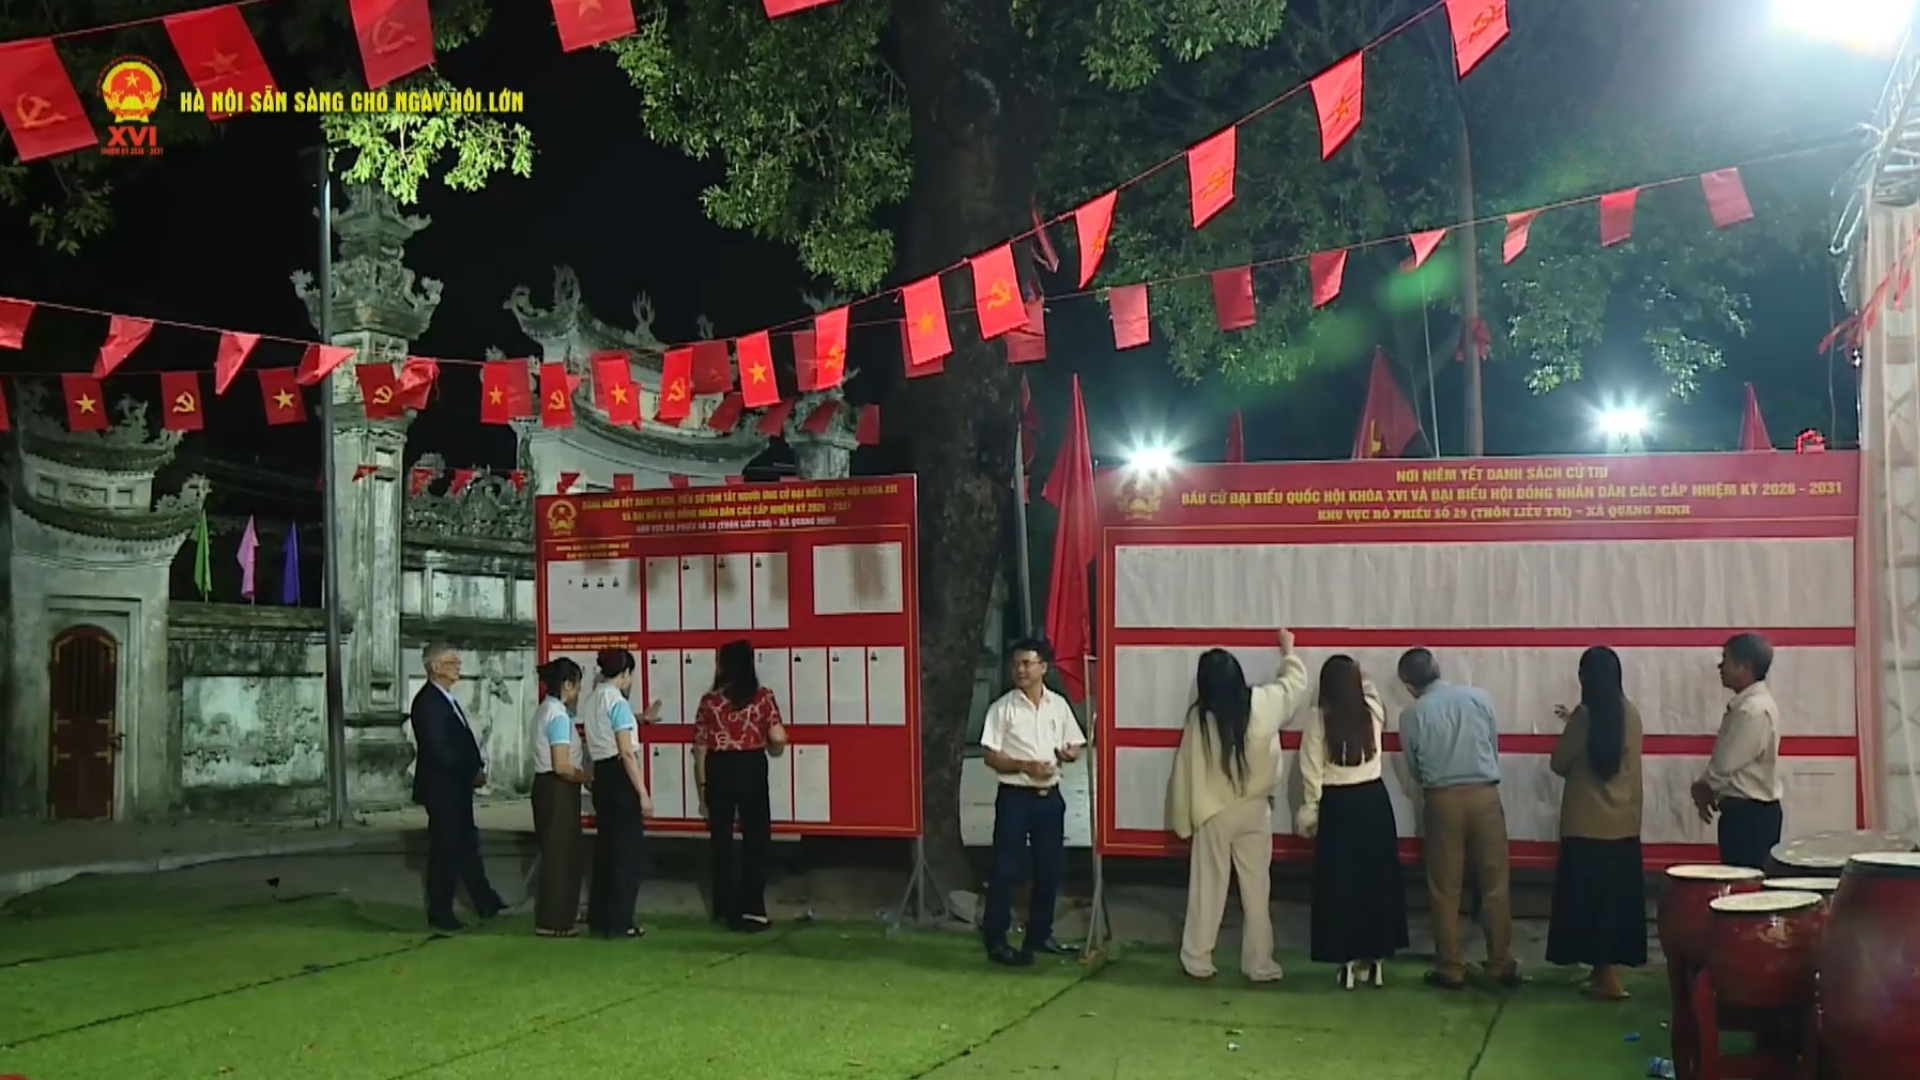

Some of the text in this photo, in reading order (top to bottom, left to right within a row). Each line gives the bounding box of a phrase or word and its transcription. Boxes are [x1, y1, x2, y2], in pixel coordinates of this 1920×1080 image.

[1396, 462, 1608, 483] NƠI NIÊM YẾT DANH SÁCH CỬ TRI
[1210, 488, 1228, 505] CỬ
[1230, 491, 1251, 508] ĐẠI
[1255, 487, 1284, 505] BIỂU
[1287, 486, 1320, 505] QUỐC
[1324, 488, 1345, 506] HỘI
[1348, 487, 1384, 503] KHÓA
[1386, 490, 1408, 503] XVI
[1411, 486, 1428, 502] VÀ
[1431, 487, 1453, 504] ĐẠI
[1457, 484, 1487, 501] BIỂU
[1490, 486, 1513, 504] HỘI
[1516, 484, 1553, 501] ĐỒNG
[1557, 484, 1594, 499] NHÂN
[1598, 483, 1625, 498] DÂN
[1629, 482, 1657, 497] CÁC
[1661, 481, 1688, 497] CẤP
[1692, 482, 1737, 499] NHIỆM
[1762, 483, 1796, 496] 2026
[1809, 481, 1842, 495] 2031
[1318, 509, 1343, 521] KHU
[1346, 508, 1369, 523] VỰC
[1373, 506, 1390, 520] BỎ
[1393, 506, 1431, 520] PHIẾU
[1434, 504, 1450, 519] SỐ
[1470, 505, 1511, 521] (THÔN
[1586, 503, 1604, 517] XÃ
[1608, 505, 1651, 518] QUANG
[1654, 505, 1691, 517] MINH
